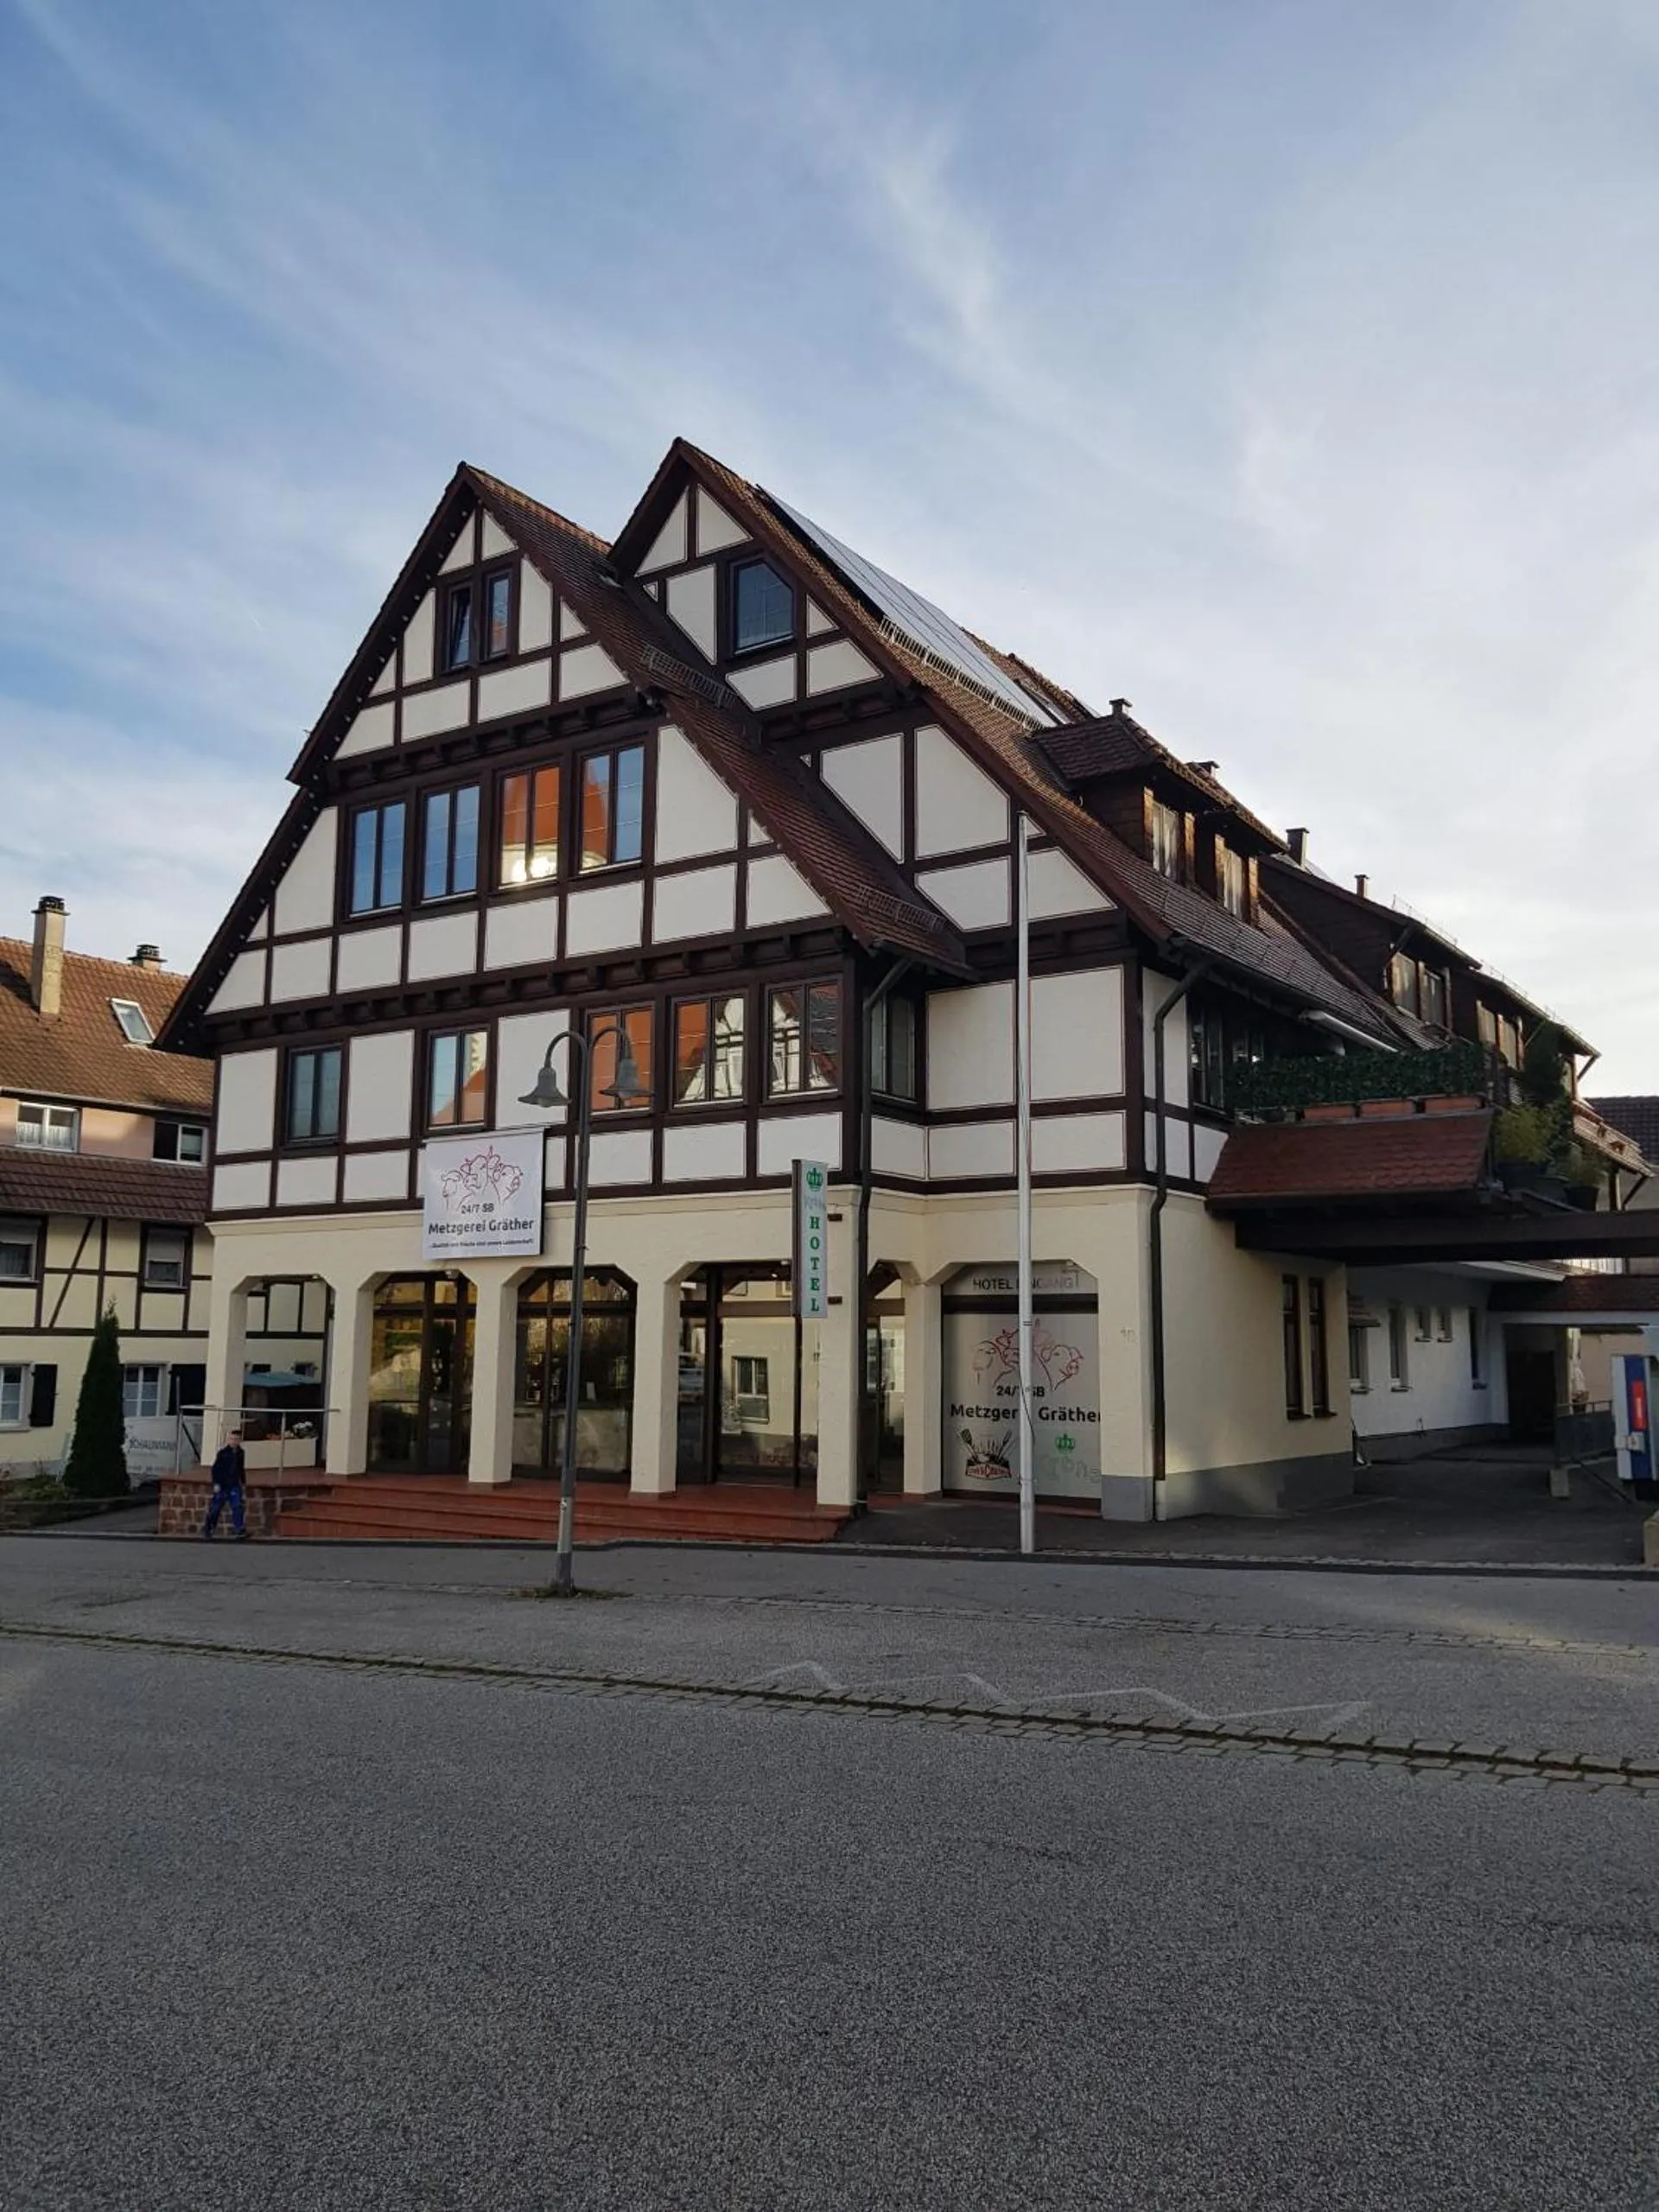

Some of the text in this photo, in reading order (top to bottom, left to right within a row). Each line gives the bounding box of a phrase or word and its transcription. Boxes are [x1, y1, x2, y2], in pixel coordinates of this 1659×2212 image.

[461, 1203, 495, 1214] 24/7 SB
[429, 1217, 534, 1236] Metzgerei Gräther
[809, 1216, 820, 1312] HOTEL
[973, 1278, 1013, 1290] HOTEL
[996, 1386, 1019, 1396] 24/
[950, 1404, 1019, 1421] Metzger
